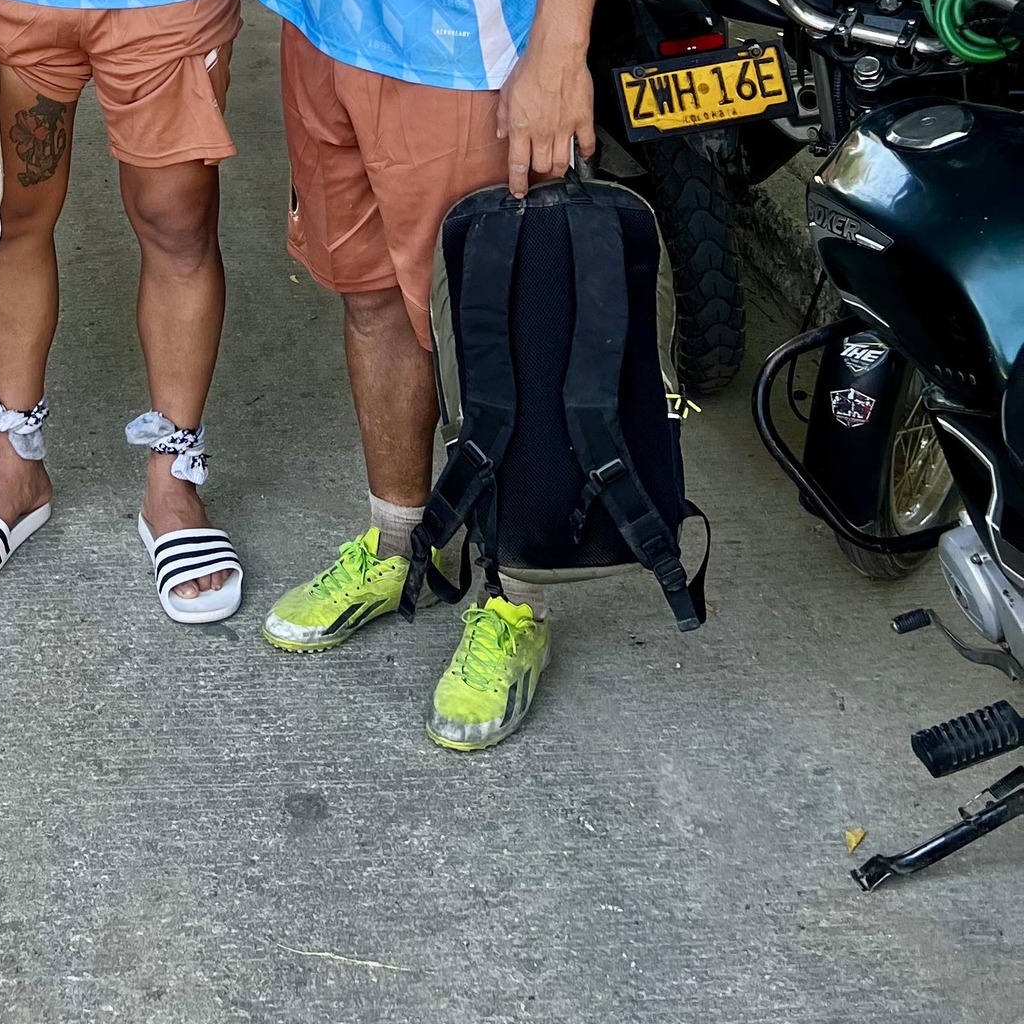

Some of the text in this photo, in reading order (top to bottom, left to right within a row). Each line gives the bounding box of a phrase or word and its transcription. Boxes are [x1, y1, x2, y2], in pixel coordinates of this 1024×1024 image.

[626, 57, 783, 121] ZWH 16E
[839, 342, 887, 363] THE
